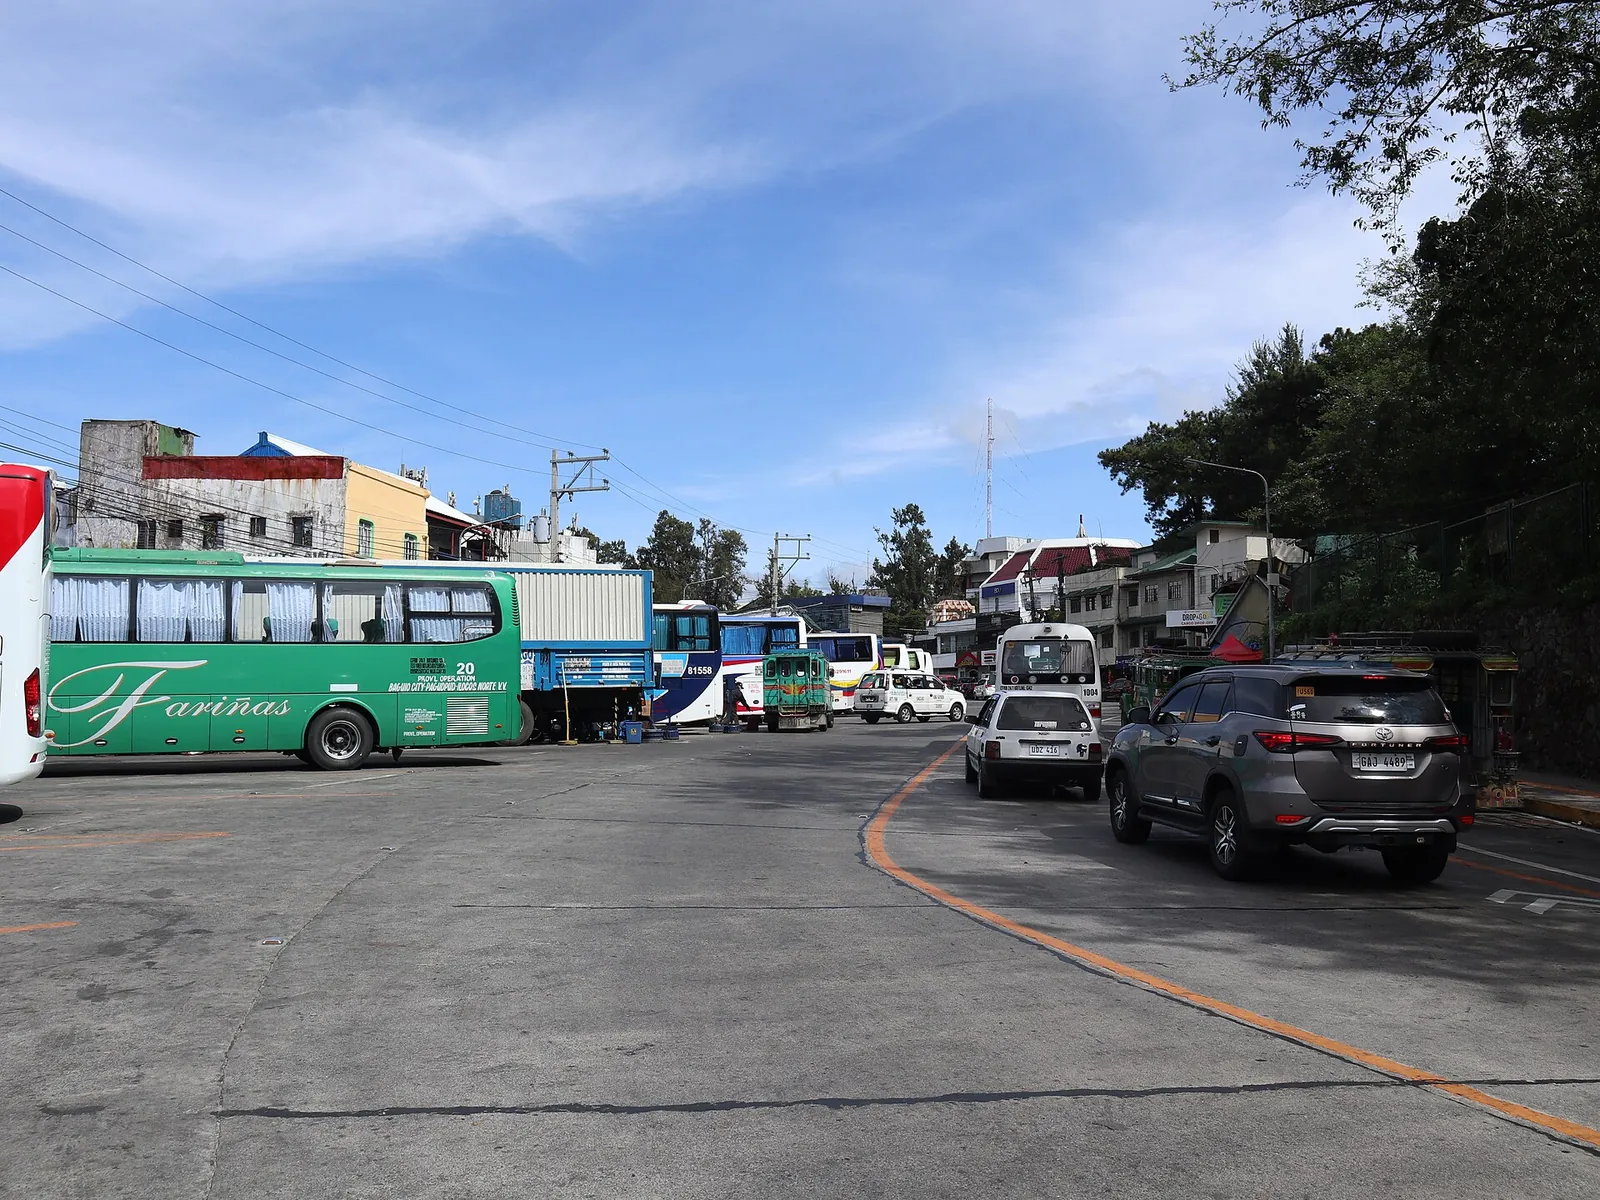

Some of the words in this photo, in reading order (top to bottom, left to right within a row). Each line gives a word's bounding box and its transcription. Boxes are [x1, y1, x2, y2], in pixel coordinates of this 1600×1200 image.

[456, 662, 475, 675] 20
[687, 666, 713, 675] 81558
[477, 682, 496, 691] NORTE
[1083, 688, 1098, 697] 1004
[48, 660, 291, 747] Fariñas
[1031, 746, 1044, 754] UDZ
[1045, 746, 1058, 754] 416
[1361, 756, 1378, 767] GAJ
[1383, 756, 1406, 767] 4489
